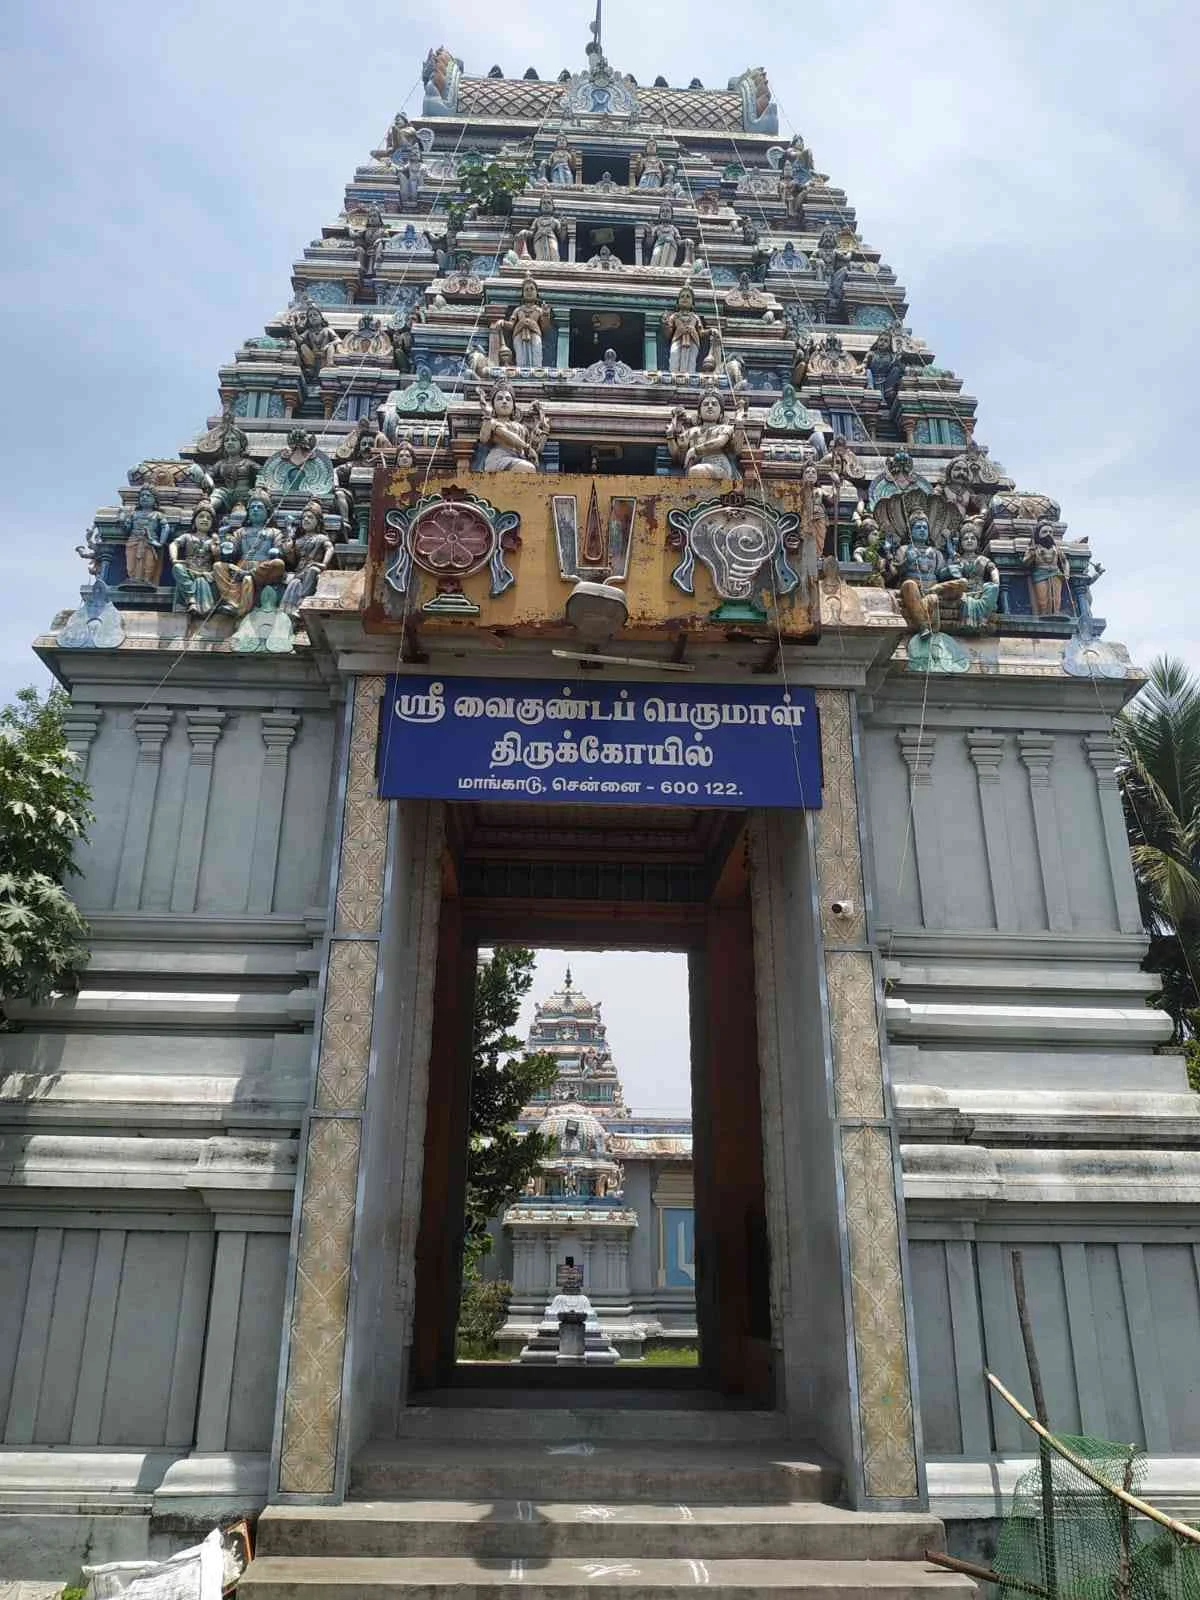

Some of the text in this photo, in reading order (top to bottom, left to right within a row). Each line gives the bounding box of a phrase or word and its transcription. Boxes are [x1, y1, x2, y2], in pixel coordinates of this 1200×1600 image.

[454, 687, 635, 725] வைகுண்டப்
[643, 694, 806, 730] பெருமாள்
[489, 729, 714, 770] திருக்கோயில்
[458, 775, 547, 795] மாங்காடு,
[552, 776, 641, 794] சென்னை
[660, 781, 699, 795] 600
[704, 782, 744, 796] 122.
